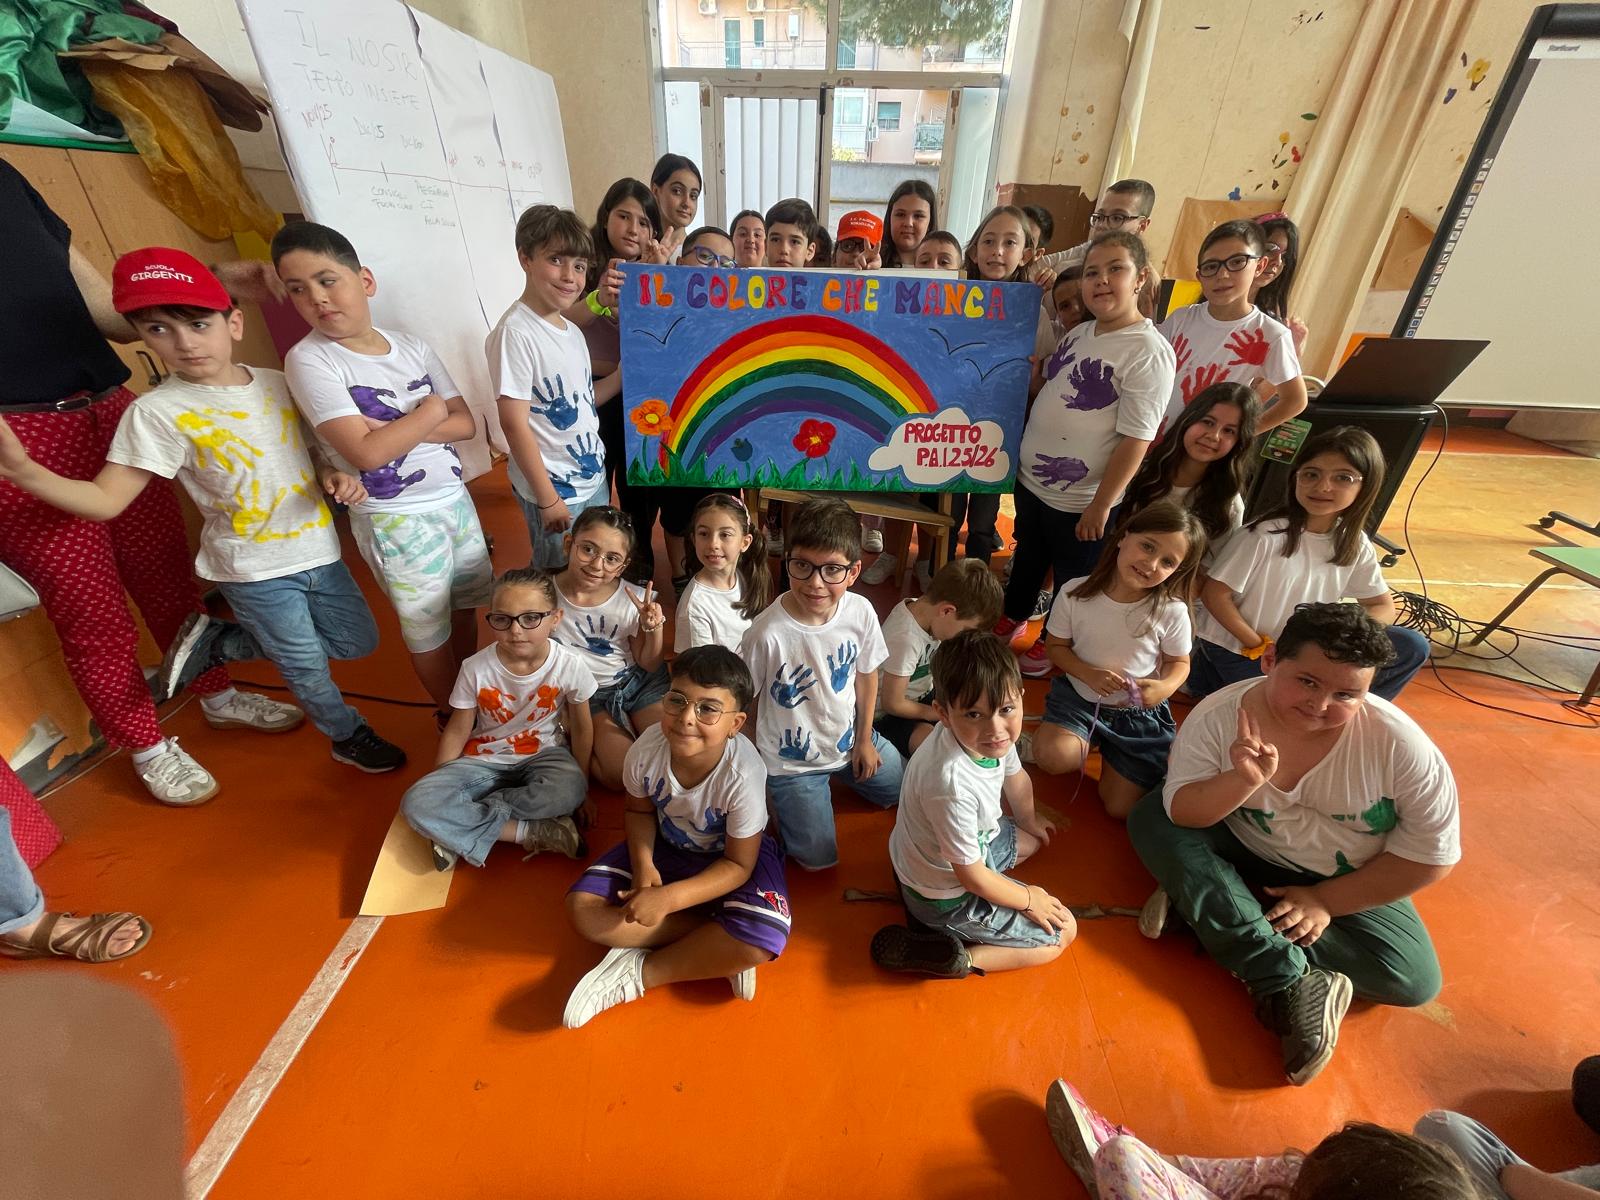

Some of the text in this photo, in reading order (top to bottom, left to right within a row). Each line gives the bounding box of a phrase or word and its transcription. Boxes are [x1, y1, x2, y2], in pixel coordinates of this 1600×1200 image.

[283, 9, 331, 57] IL
[130, 271, 194, 283] GIRGENTI
[144, 264, 175, 272] SCUOLA
[639, 272, 1005, 320] IL COLORE CHE MANCA
[903, 422, 982, 444] PROGETTO
